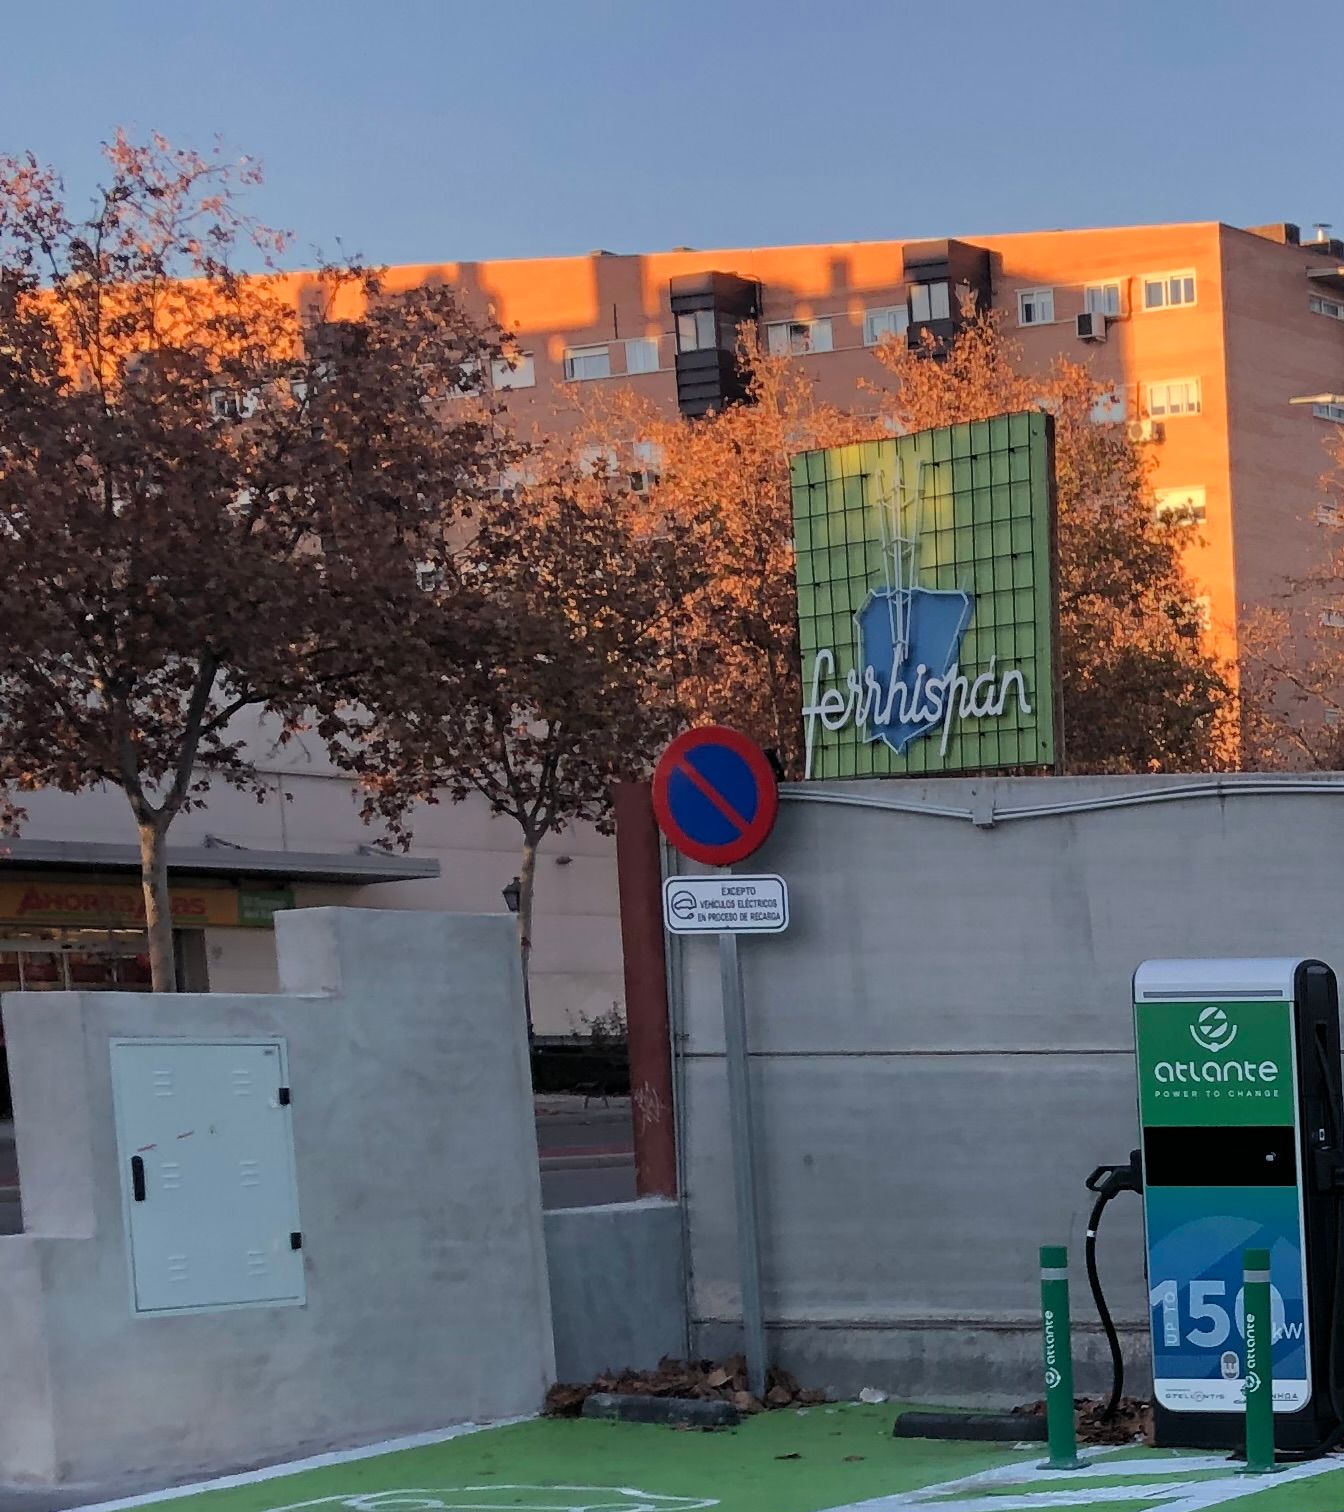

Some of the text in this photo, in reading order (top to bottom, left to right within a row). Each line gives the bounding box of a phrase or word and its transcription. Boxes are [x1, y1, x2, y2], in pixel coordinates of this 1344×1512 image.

[721, 887, 756, 896] EXCEPTO
[1154, 1060, 1278, 1083] atlante
[1154, 1089, 1279, 1098] POWER TO CHANGE
[1163, 1291, 1178, 1345] UP TO
[1044, 1310, 1054, 1365] atlante
[1246, 1313, 1256, 1369] atlante
